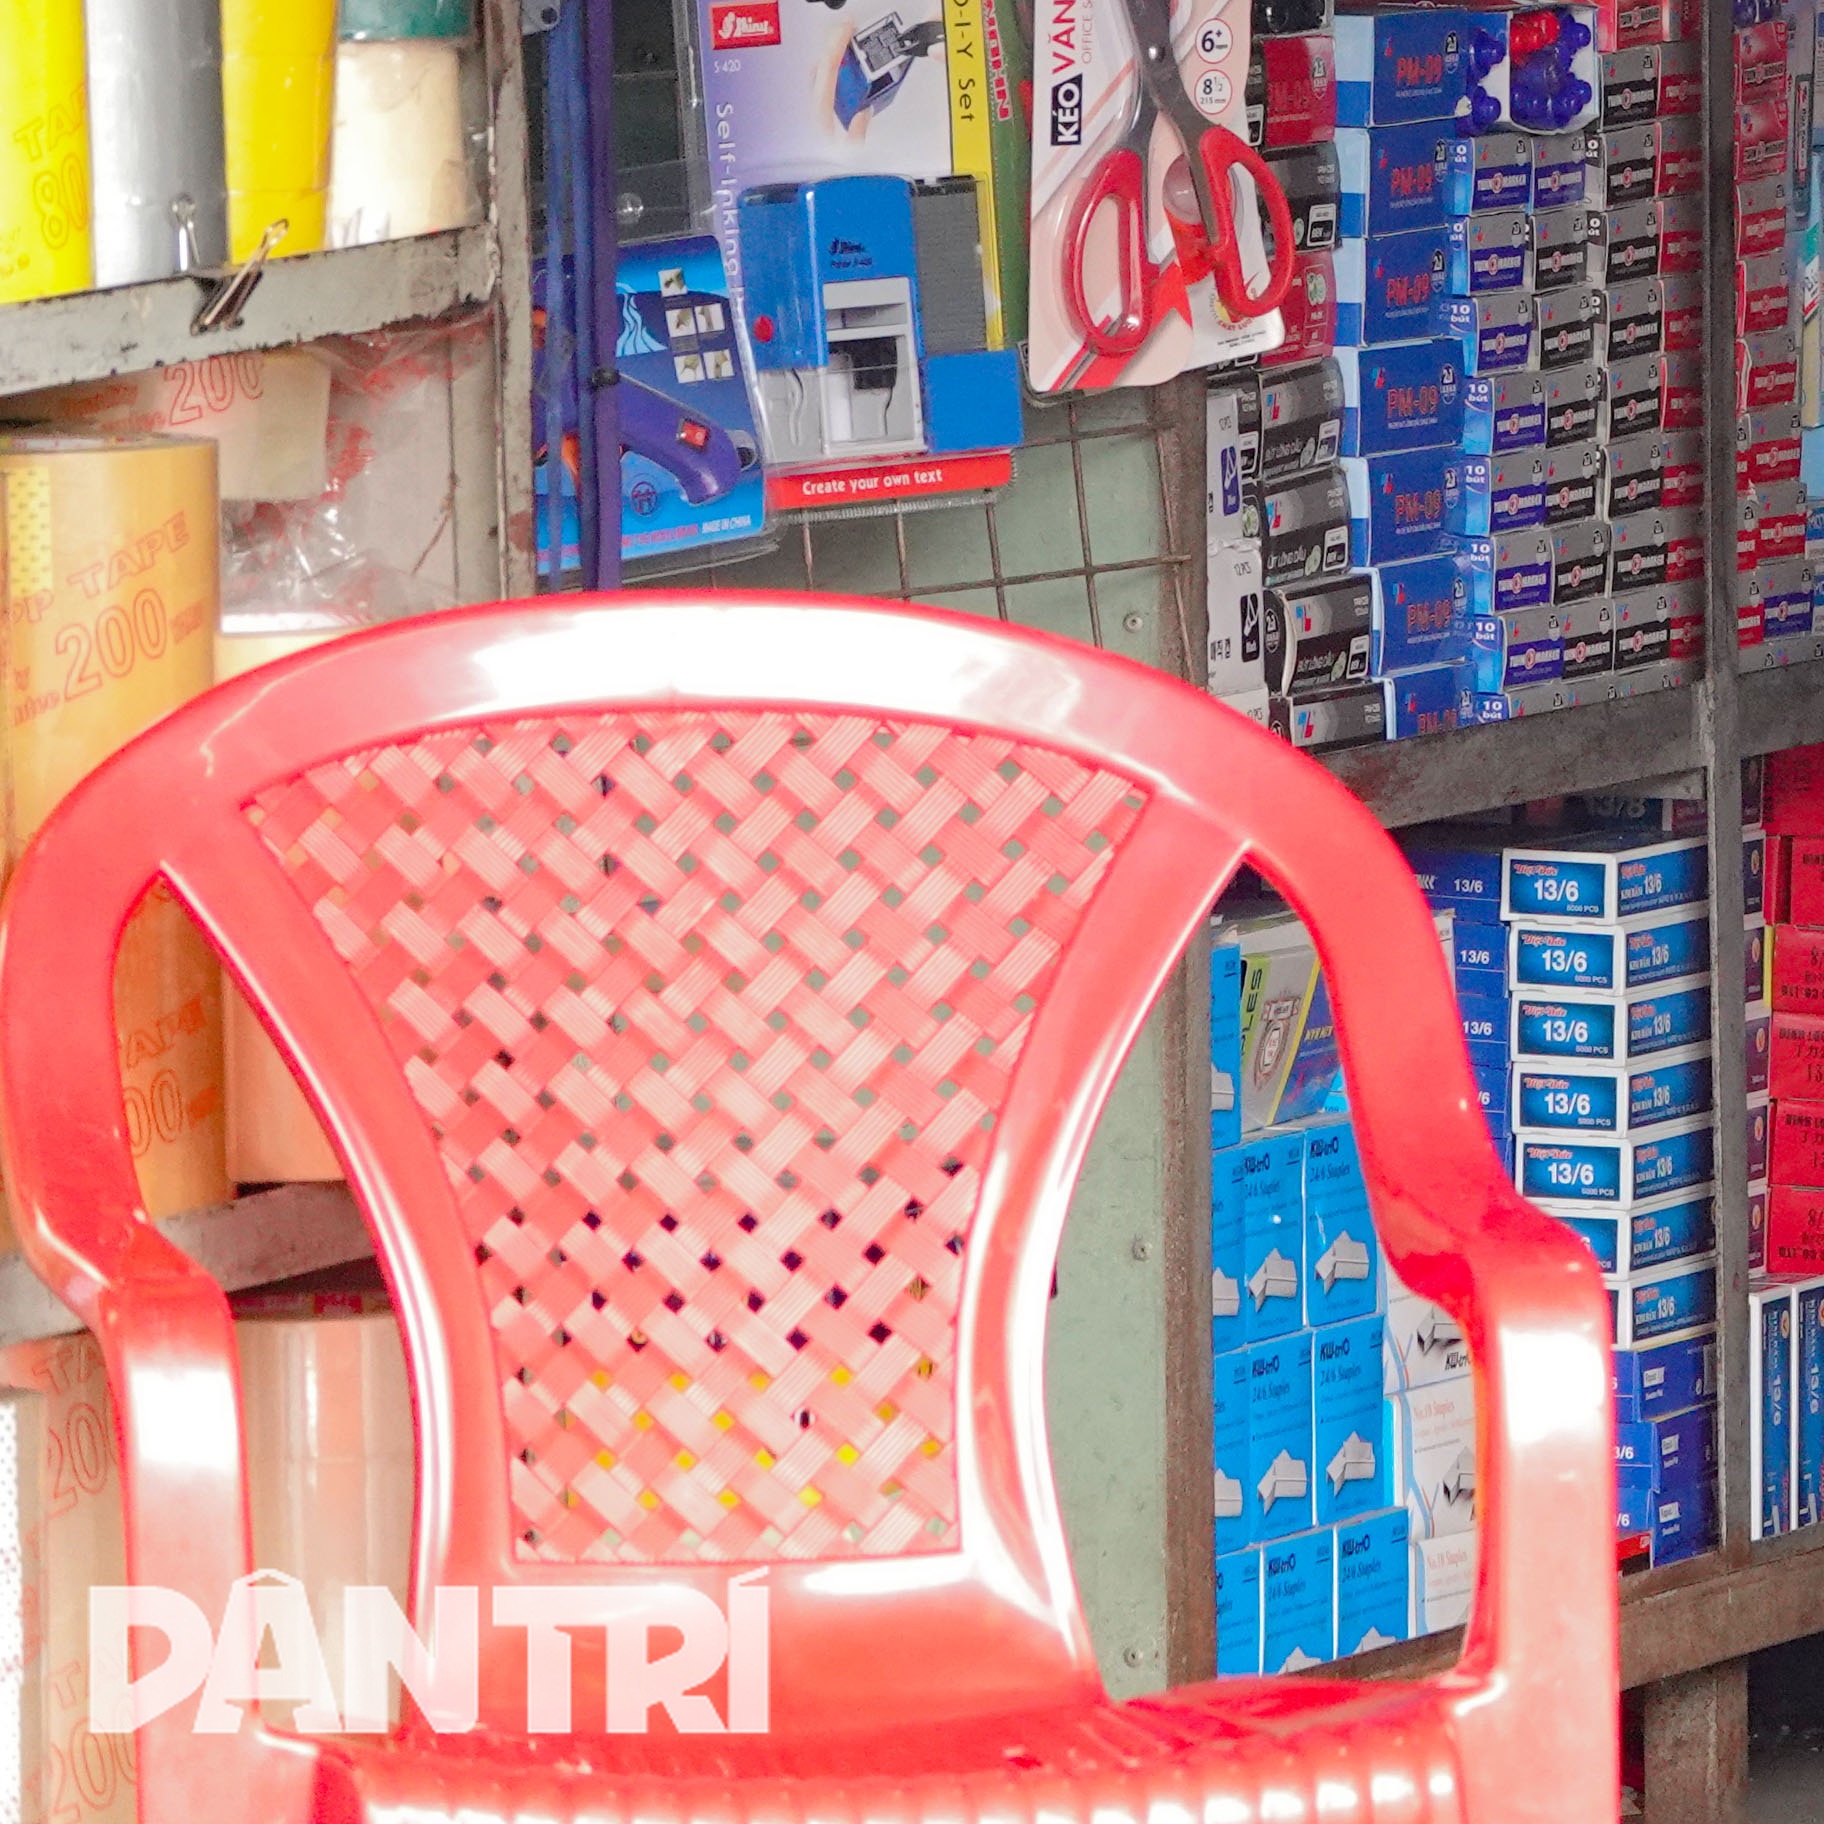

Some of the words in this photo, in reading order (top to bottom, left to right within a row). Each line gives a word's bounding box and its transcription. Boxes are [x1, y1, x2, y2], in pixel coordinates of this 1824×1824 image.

[1082, 16, 1094, 64] OFFICE
[959, 79, 975, 123] Set
[1057, 77, 1080, 147] KÉO
[1468, 383, 1488, 394] 10
[1469, 392, 1488, 403] bút
[802, 479, 842, 496] Create
[851, 477, 878, 494] your
[884, 475, 911, 488] own
[916, 469, 943, 486] text
[67, 510, 190, 599] TAPE
[56, 588, 168, 702] 200
[1533, 880, 1579, 902] 13/6
[1643, 874, 1663, 895] 13/6
[1542, 951, 1587, 973] 13/6
[1651, 945, 1670, 964] 13/6
[1542, 1020, 1588, 1043] 13/6
